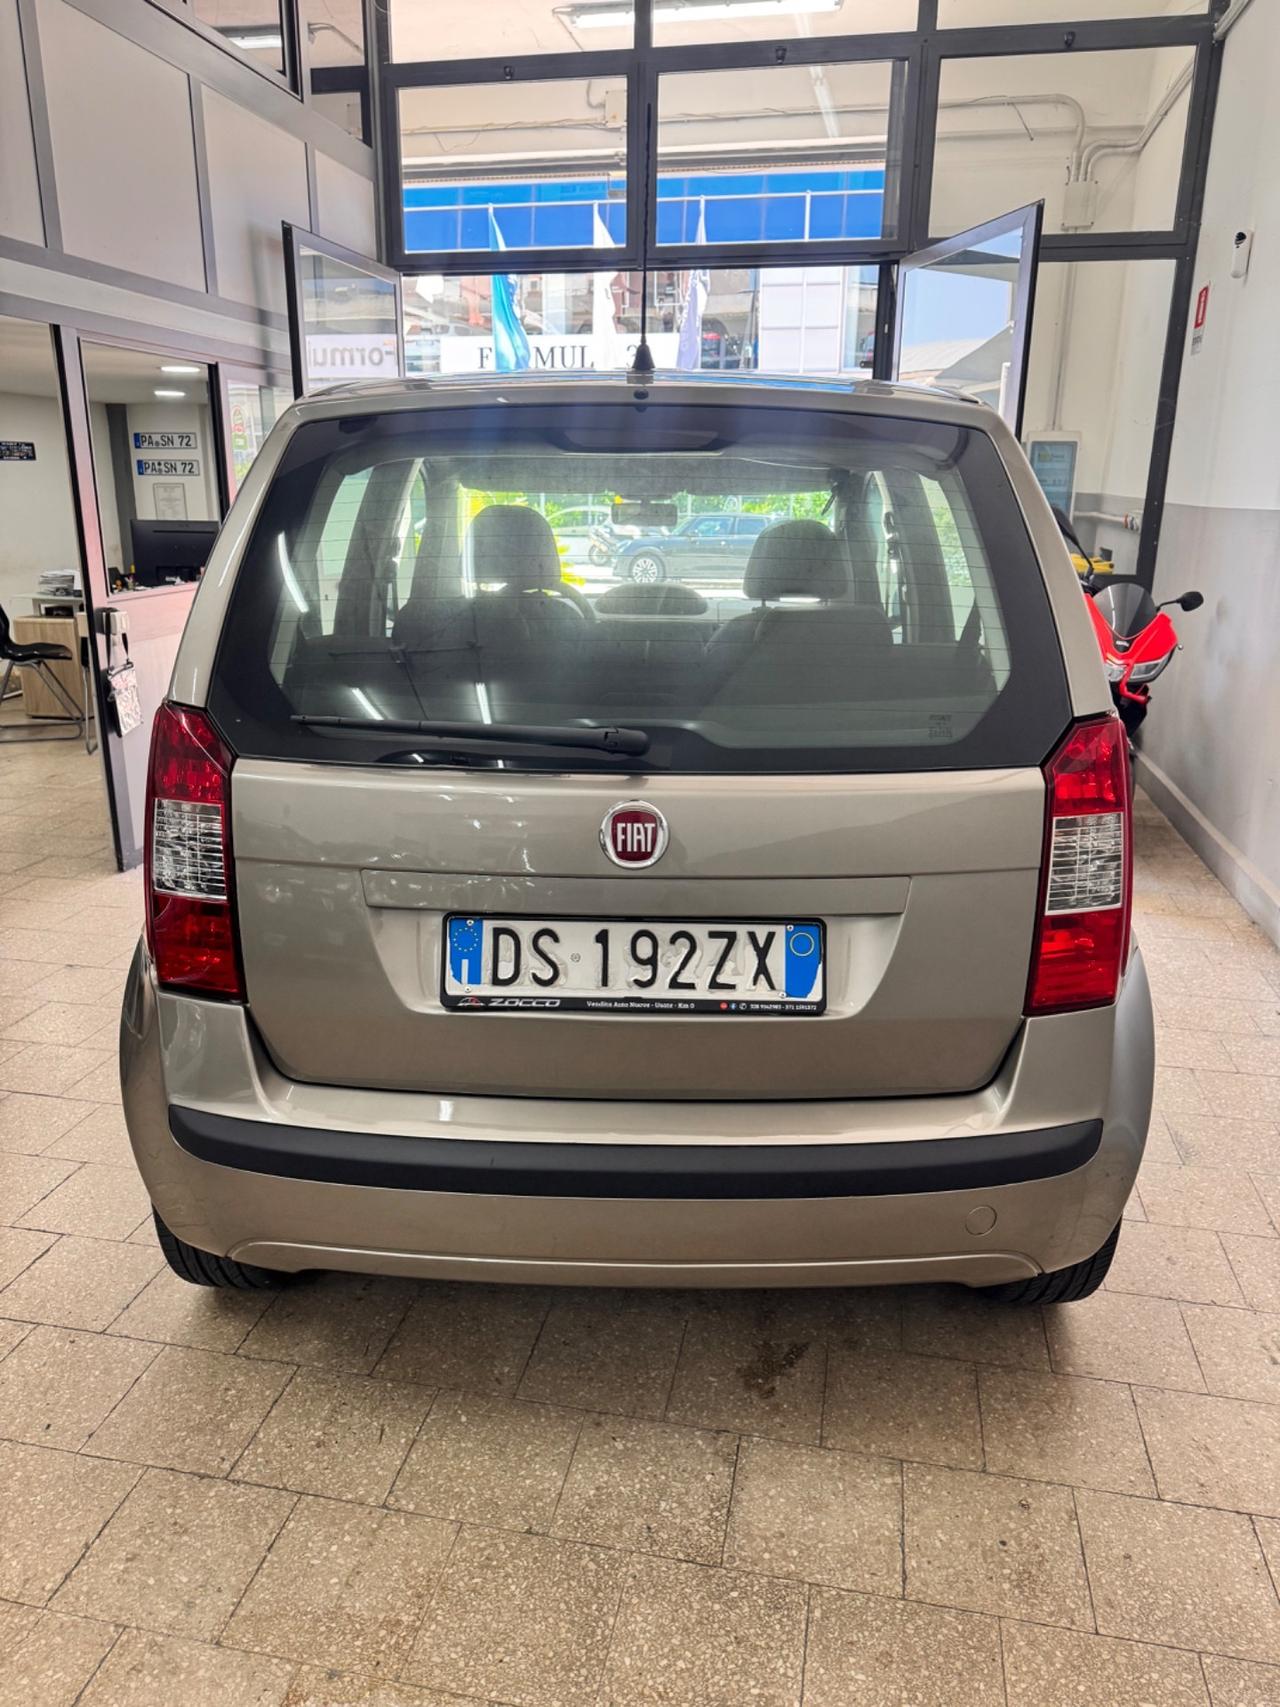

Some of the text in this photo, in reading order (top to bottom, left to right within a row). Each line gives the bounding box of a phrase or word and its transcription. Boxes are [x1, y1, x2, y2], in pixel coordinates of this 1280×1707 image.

[141, 435, 154, 447] PA
[178, 435, 192, 447] 72
[144, 462, 156, 474] PA
[181, 462, 194, 473] 72
[616, 822, 656, 853] FIAT
[491, 927, 777, 990] DS 192ZX
[487, 998, 562, 1008] ZOCCO
